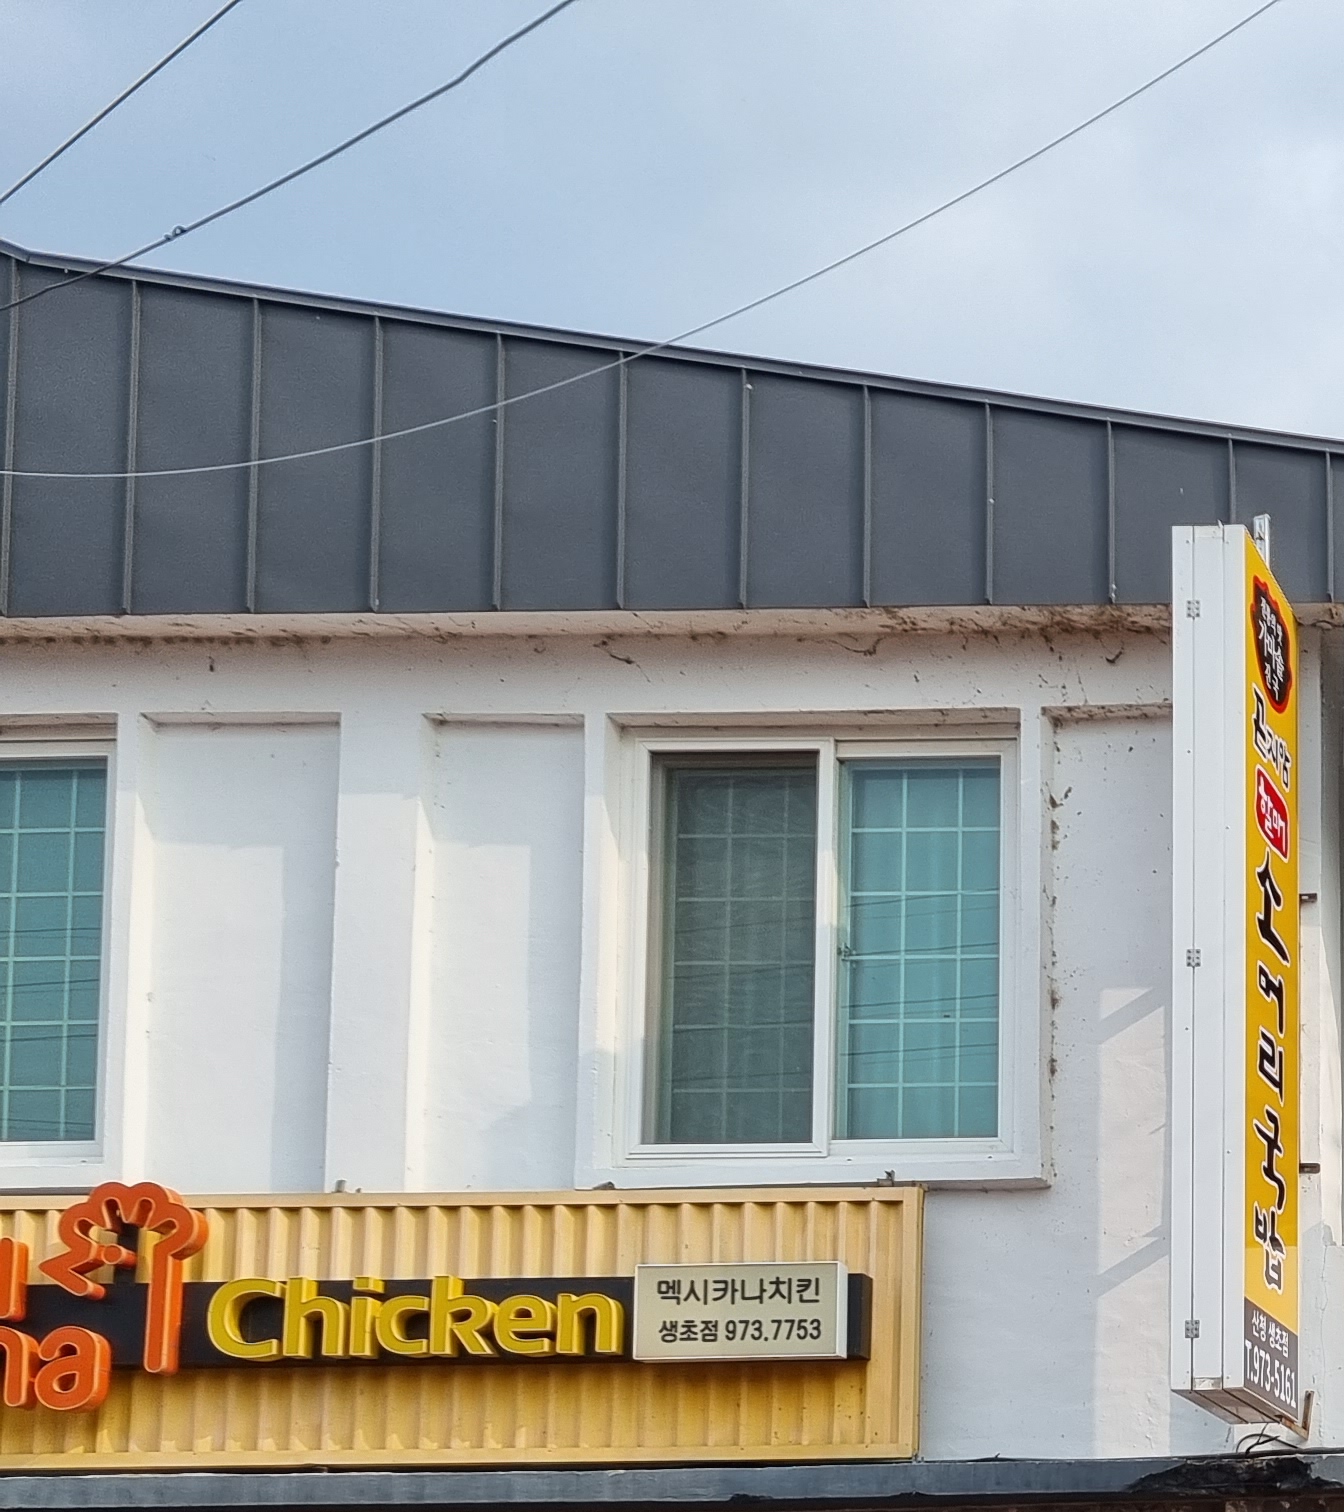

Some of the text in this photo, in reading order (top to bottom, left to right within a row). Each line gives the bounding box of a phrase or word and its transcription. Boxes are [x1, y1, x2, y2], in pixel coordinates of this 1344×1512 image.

[1253, 683, 1291, 790] 곤지암
[1258, 773, 1287, 854] 할매
[1253, 850, 1291, 1293] 소머리국밥
[208, 1274, 625, 1361] Chicken
[656, 1277, 823, 1308] 멕시카나치킨
[657, 1314, 824, 1345] 생초점 973.7753
[1252, 1309, 1289, 1359] 산청 생초점
[1245, 1339, 1297, 1409] T.973-5161
